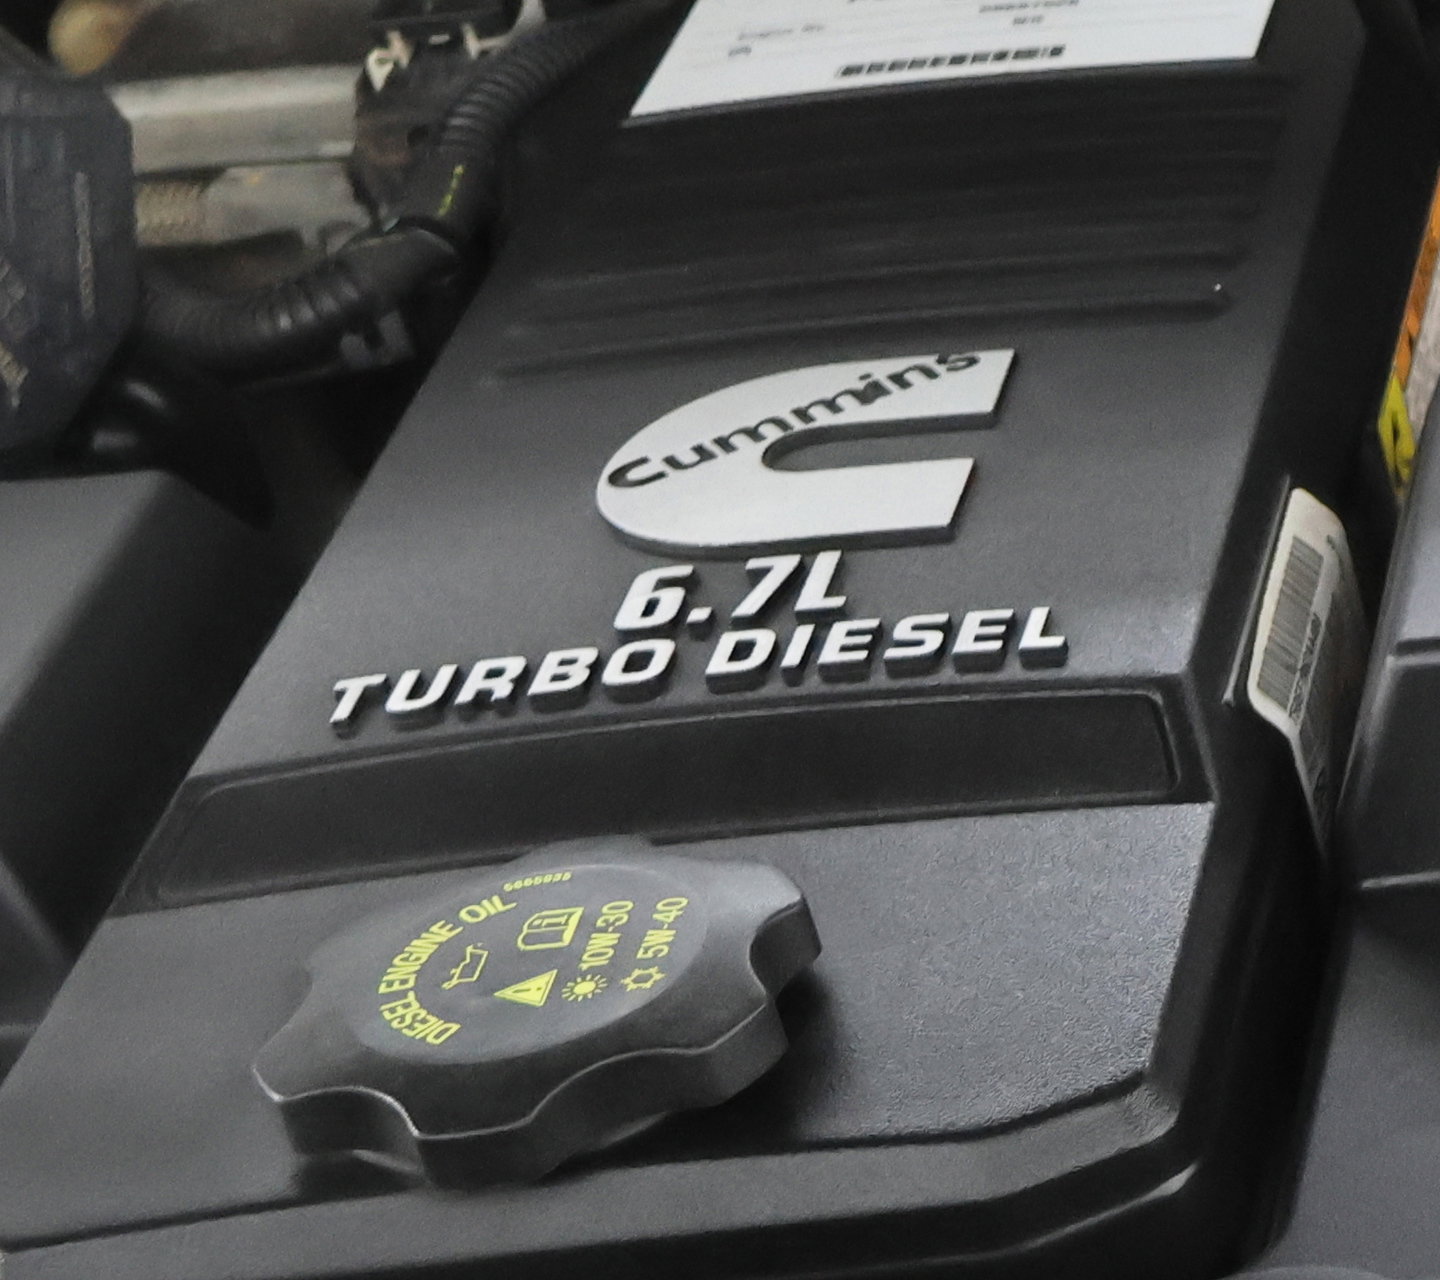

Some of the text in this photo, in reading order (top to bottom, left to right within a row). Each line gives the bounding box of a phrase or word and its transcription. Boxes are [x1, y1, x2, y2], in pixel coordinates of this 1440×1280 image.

[607, 351, 981, 489] Cummins
[612, 550, 849, 633] 6.7L
[329, 606, 1068, 723] TURBO DIESEL
[378, 894, 518, 1046] DIESEL ENGINE OIL
[578, 899, 636, 971] 10W-30
[635, 896, 690, 960] 5W-40
